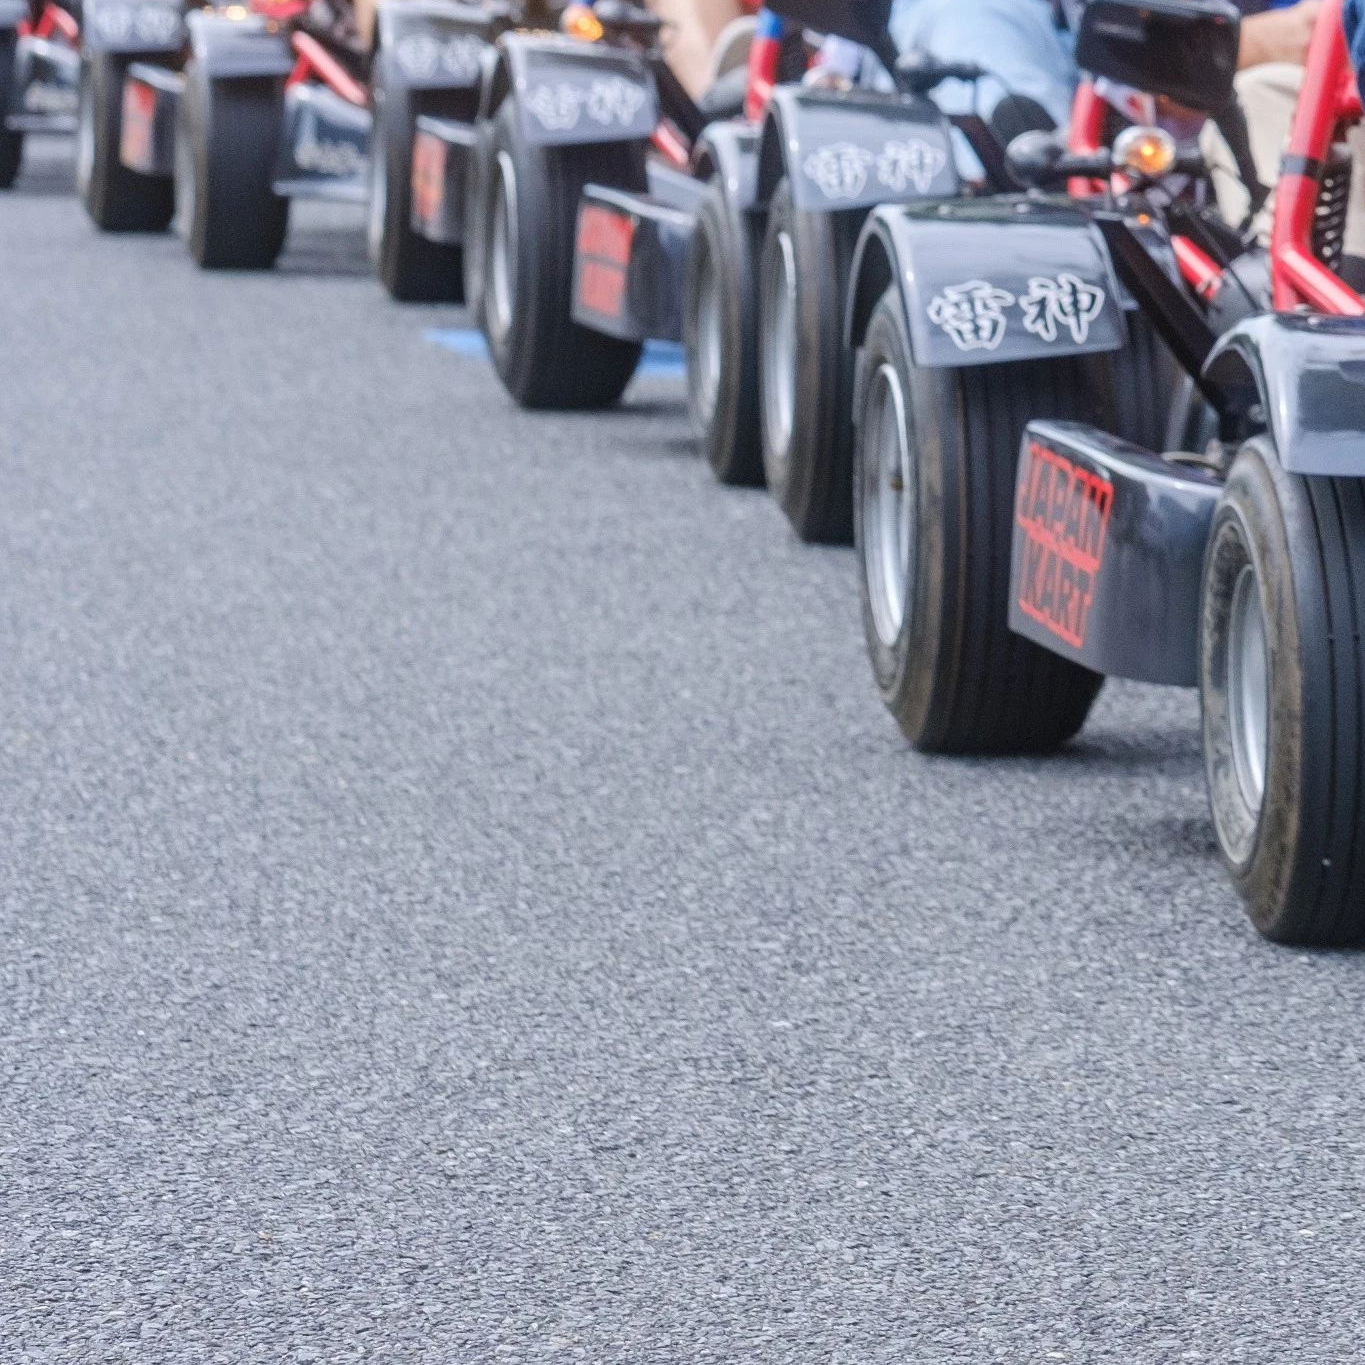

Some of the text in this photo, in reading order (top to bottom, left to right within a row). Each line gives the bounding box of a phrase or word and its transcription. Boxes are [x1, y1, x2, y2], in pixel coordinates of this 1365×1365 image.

[927, 273, 1105, 351] 雷神
[1016, 443, 1114, 567] JAPAN
[1018, 525, 1094, 649] KART
